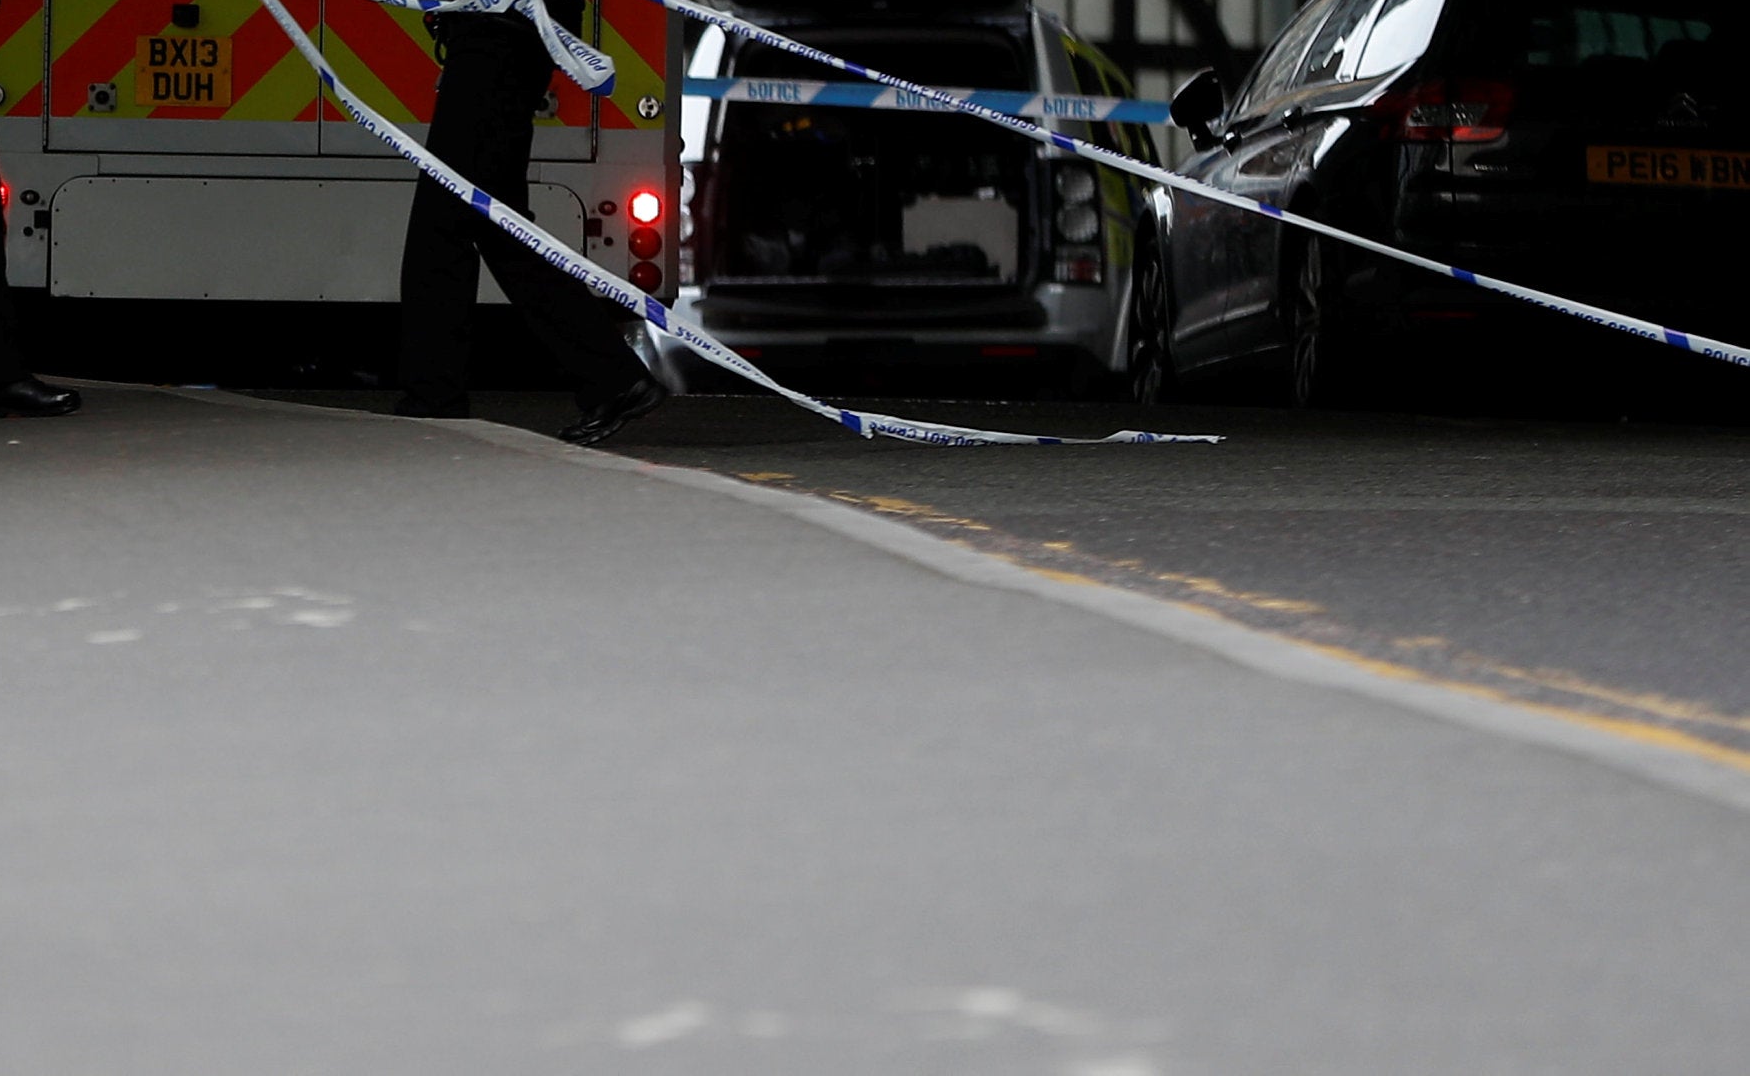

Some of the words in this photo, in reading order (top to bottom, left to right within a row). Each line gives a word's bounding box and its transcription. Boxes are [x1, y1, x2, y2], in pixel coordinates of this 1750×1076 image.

[148, 38, 219, 67] BX13
[152, 71, 214, 101] DUH
[1606, 151, 1680, 181] PE16
[498, 216, 541, 249] CROSS
[543, 246, 568, 270] NOT
[569, 261, 590, 281] DO
[592, 274, 639, 310] POLICE
